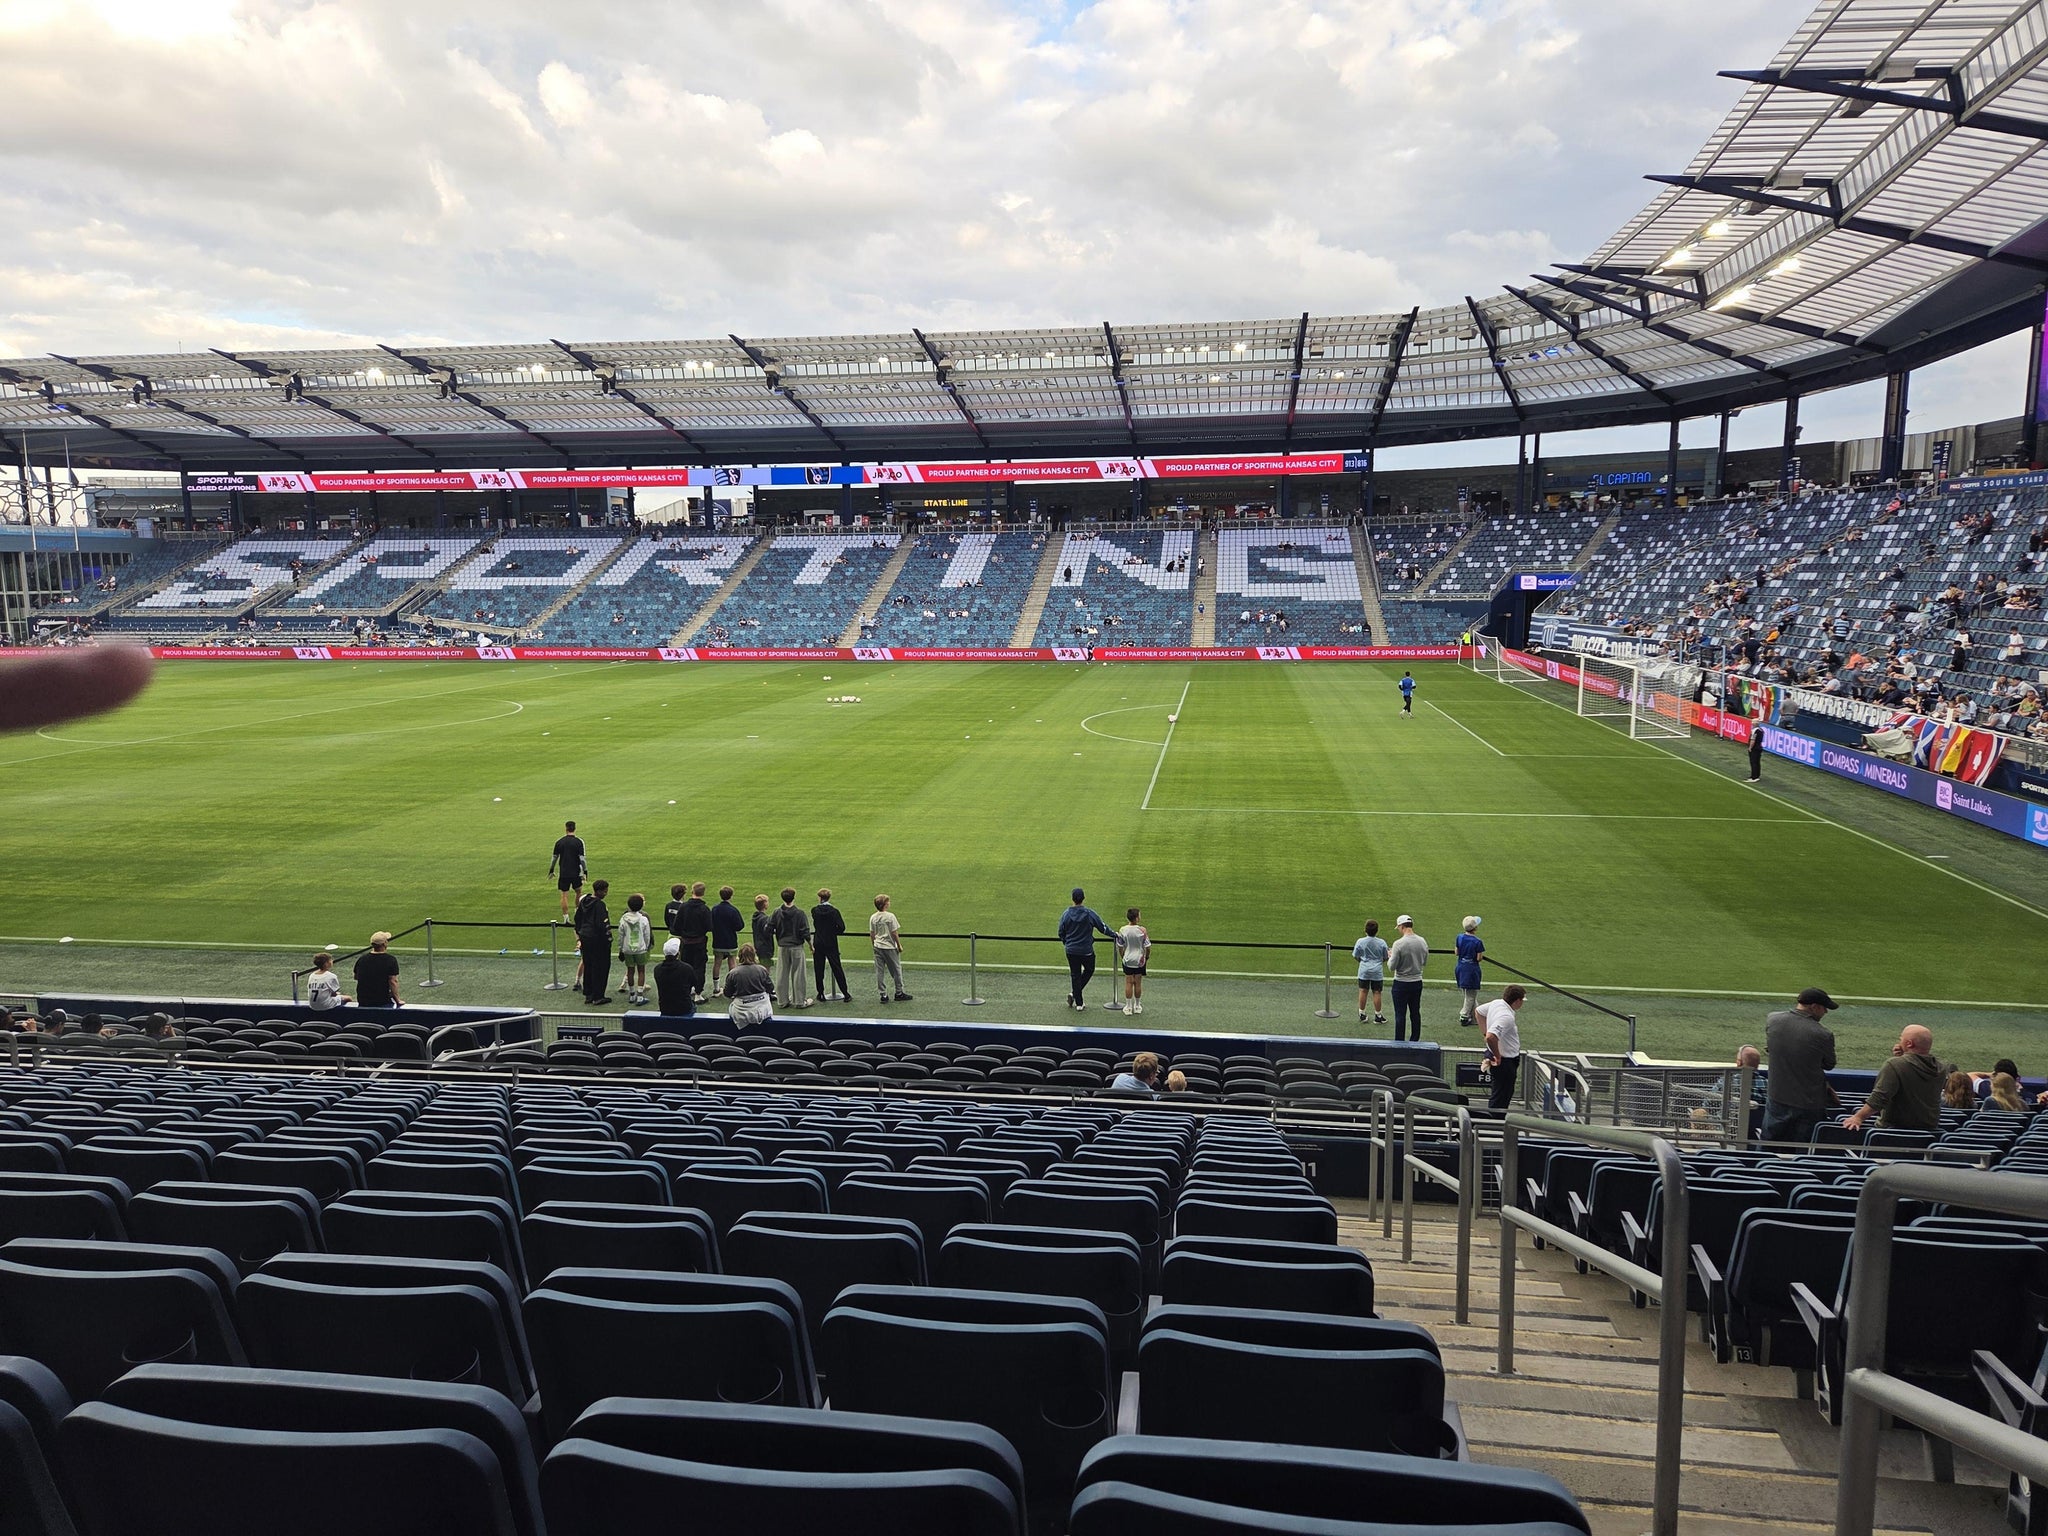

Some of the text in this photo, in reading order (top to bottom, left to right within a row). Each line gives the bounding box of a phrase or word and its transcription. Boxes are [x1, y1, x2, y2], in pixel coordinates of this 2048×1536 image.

[1003, 468, 1039, 476] SPORTING
[1608, 472, 1651, 485] CAPITAN
[1984, 478, 2014, 487] SOUTH
[2019, 476, 2043, 484] STAND
[1703, 712, 1717, 726] Audi
[1762, 726, 1816, 764] OWERADE
[1823, 750, 1907, 790] COMPASS MINERALS
[1953, 793, 1970, 809] Saint
[312, 990, 319, 1002] 7
[1302, 1162, 1316, 1177] 11
[1738, 1350, 1750, 1360] 13
